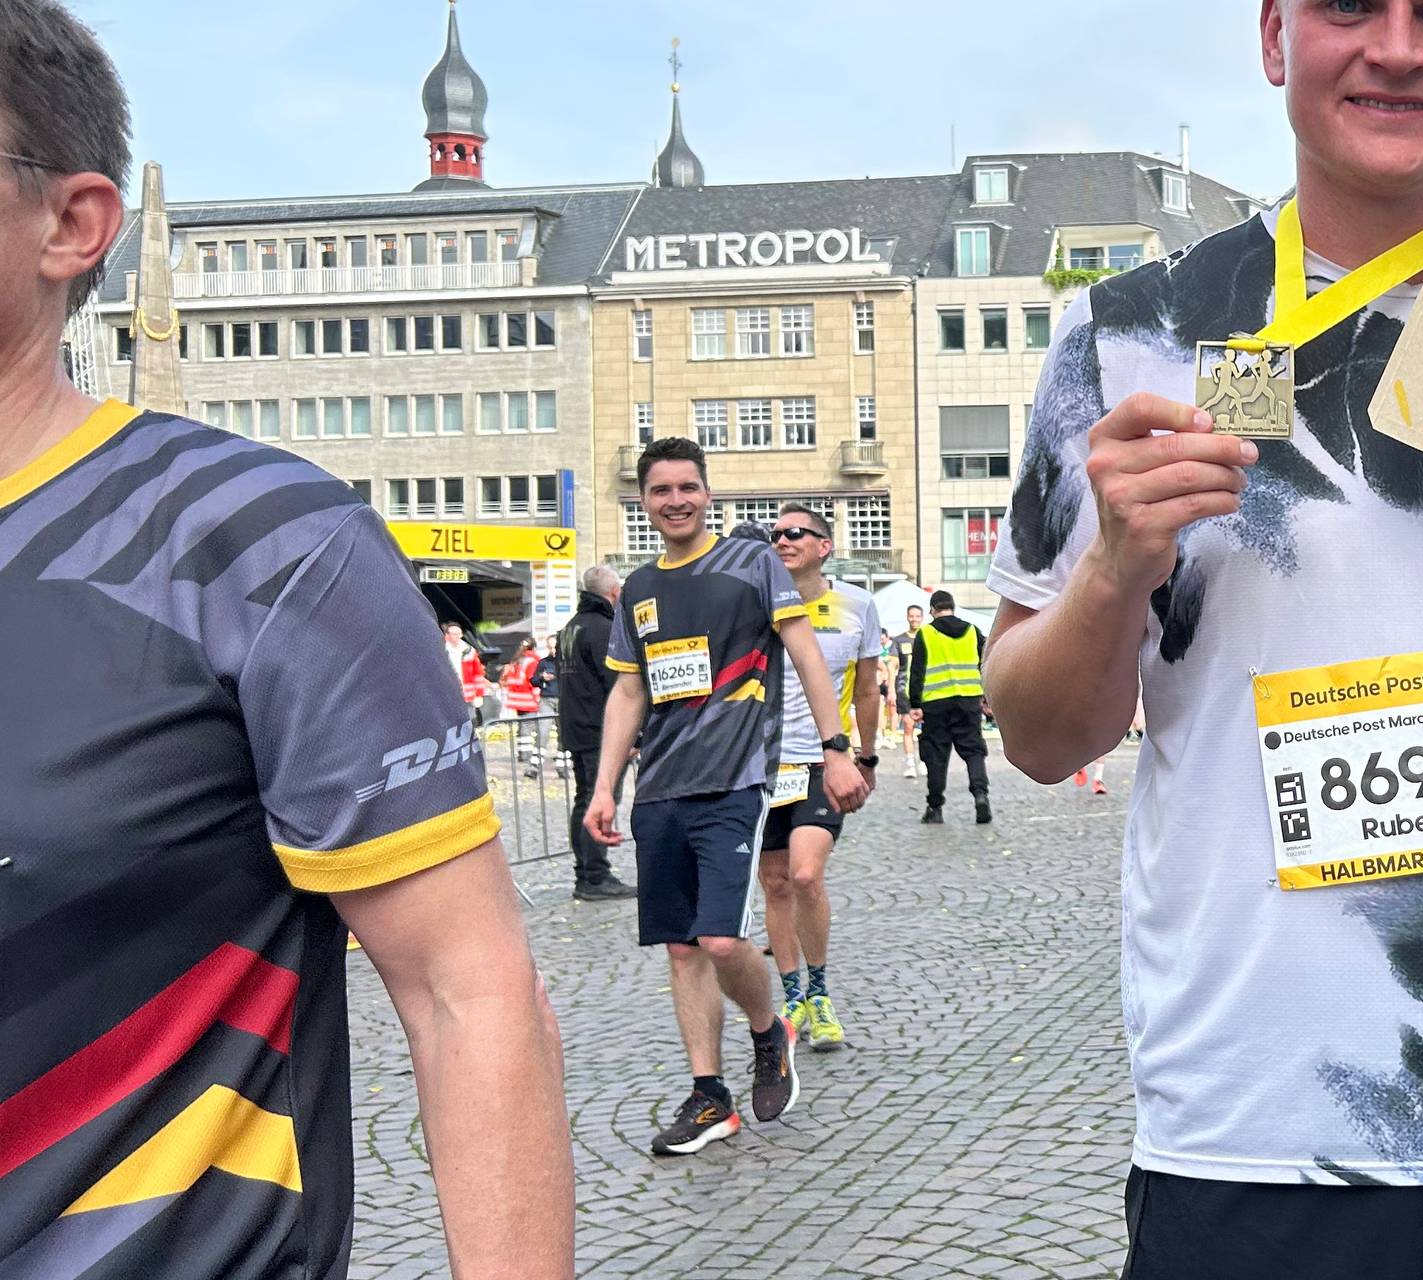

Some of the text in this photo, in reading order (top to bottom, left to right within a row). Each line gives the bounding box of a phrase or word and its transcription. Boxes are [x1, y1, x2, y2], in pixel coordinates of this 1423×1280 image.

[625, 227, 881, 272] METROPOL
[430, 528, 475, 553] ZIEL
[657, 664, 695, 681] 16265
[1290, 681, 1381, 708] Deutsche
[1284, 725, 1350, 744] Deutsche
[1353, 719, 1386, 733] Post
[382, 719, 479, 791] DH
